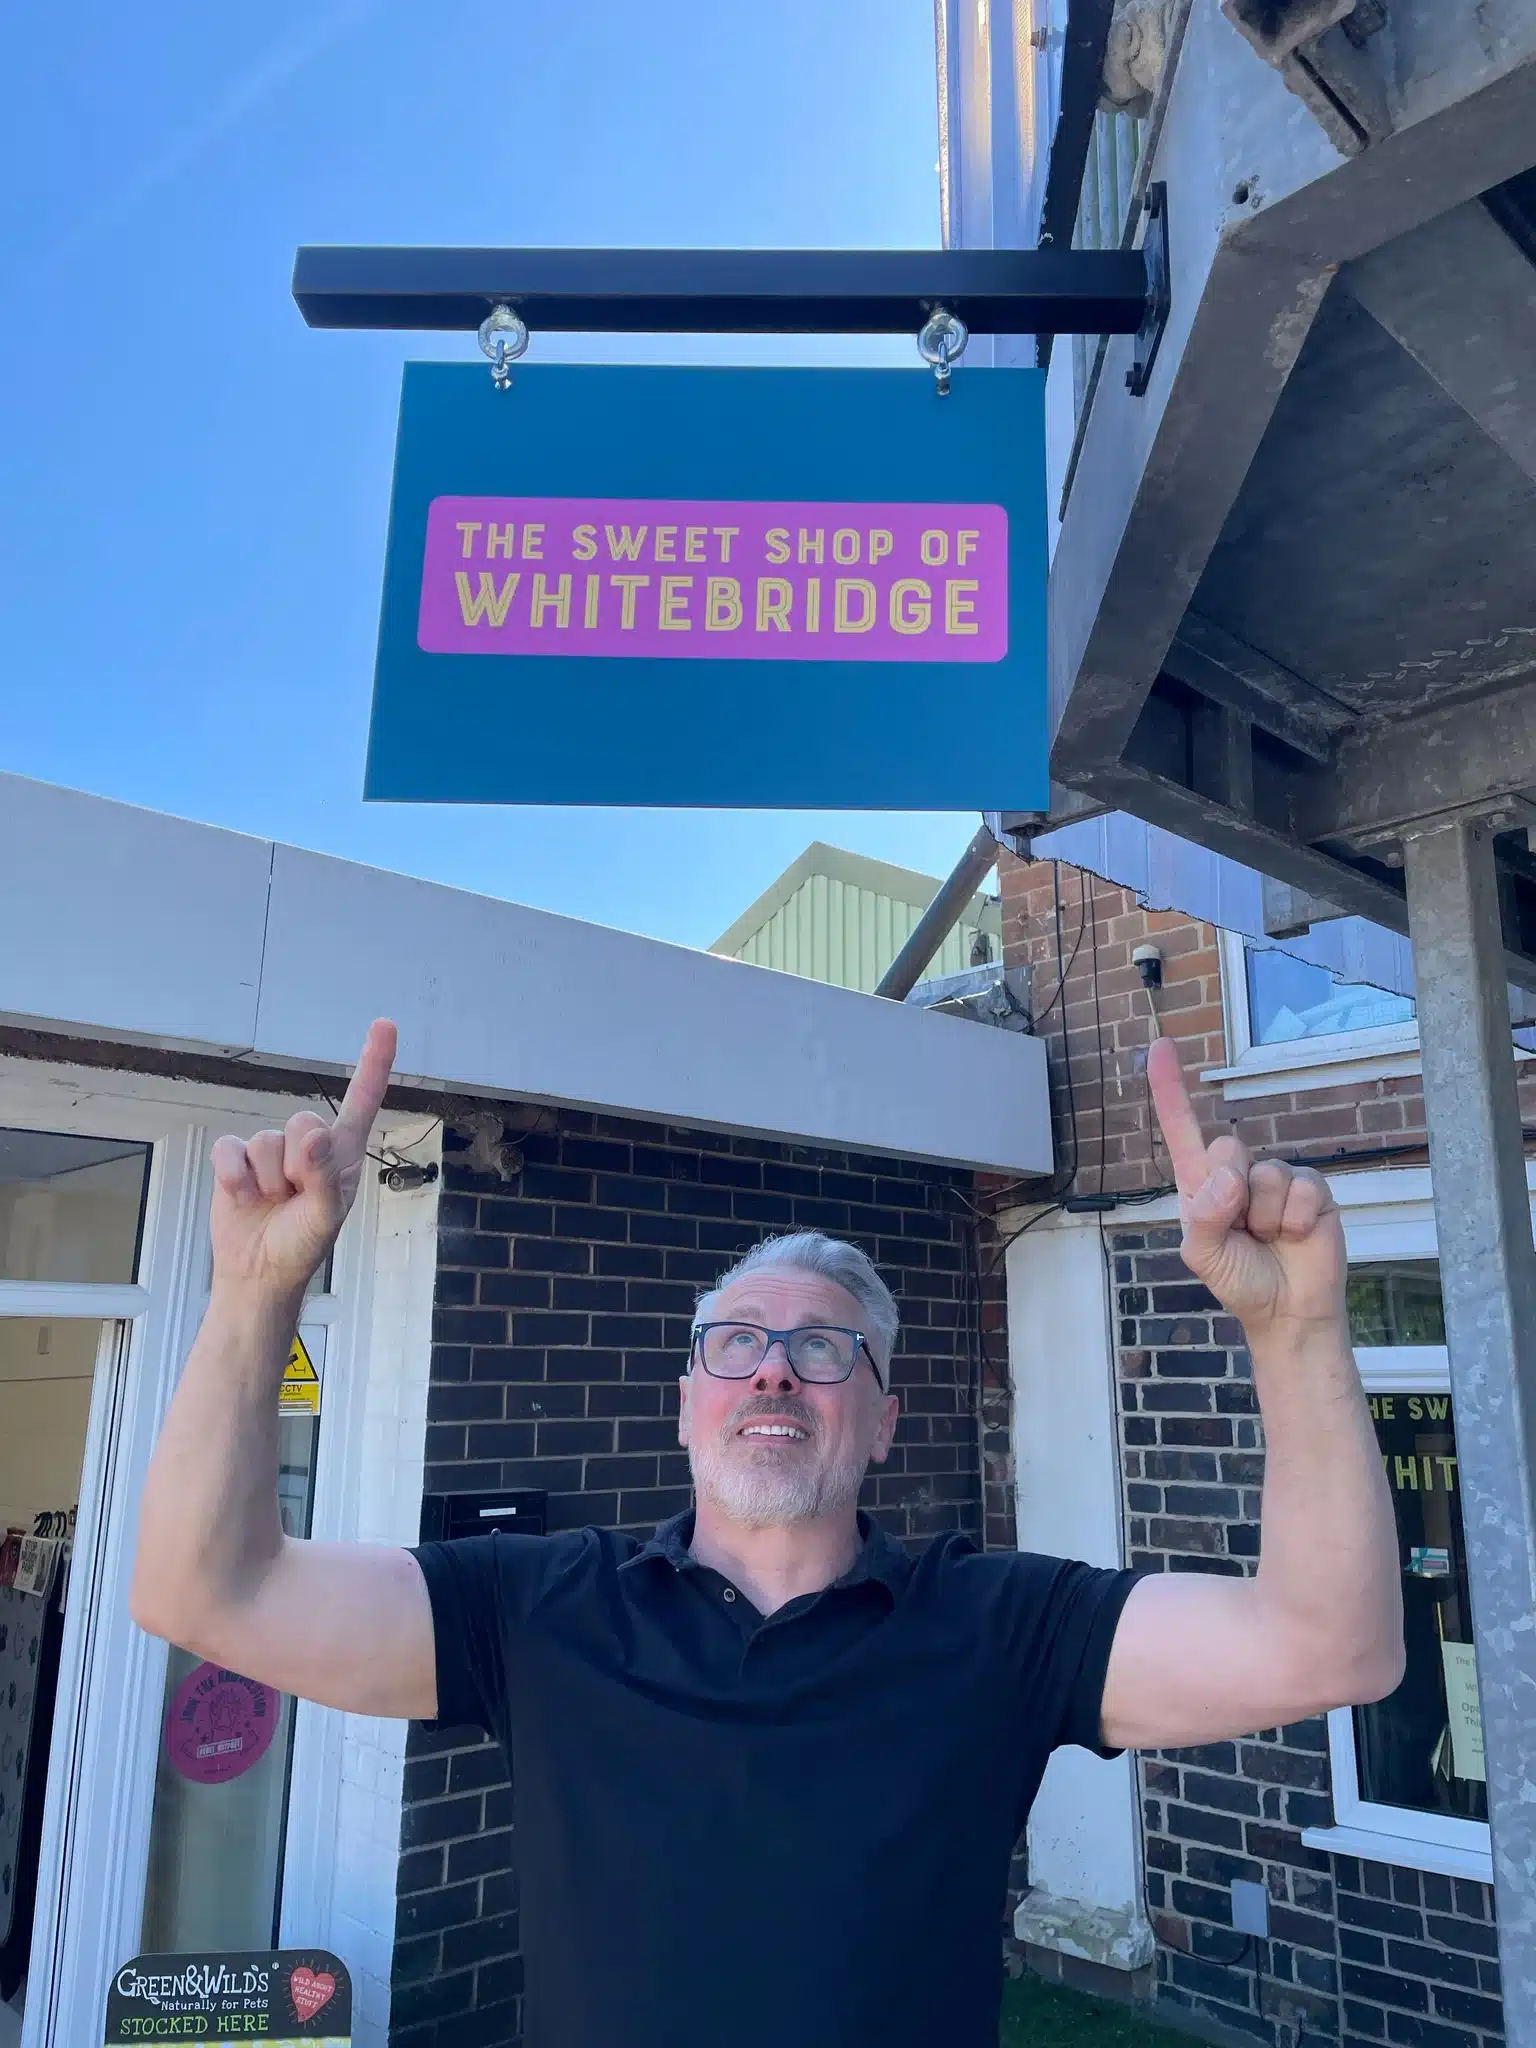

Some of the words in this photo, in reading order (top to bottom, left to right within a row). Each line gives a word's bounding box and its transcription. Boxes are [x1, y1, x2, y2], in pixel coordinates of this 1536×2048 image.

[456, 522, 545, 560] THE
[572, 524, 740, 563] SWEET
[765, 528, 894, 565] SHOP
[920, 529, 980, 566] OF
[455, 572, 979, 635] WHITEBRIDGE
[1368, 1397, 1396, 1420] HE
[1407, 1397, 1449, 1420] SW
[1381, 1455, 1457, 1491] HIT
[295, 1986, 326, 2000] HEALTHY
[311, 1981, 333, 1992] ABOUT
[161, 2000, 217, 2012] Naturally
[221, 1999, 239, 2010] for
[243, 1998, 269, 2009] Pets
[120, 2016, 209, 2035] STOCKED
[217, 2014, 270, 2032] HERE
